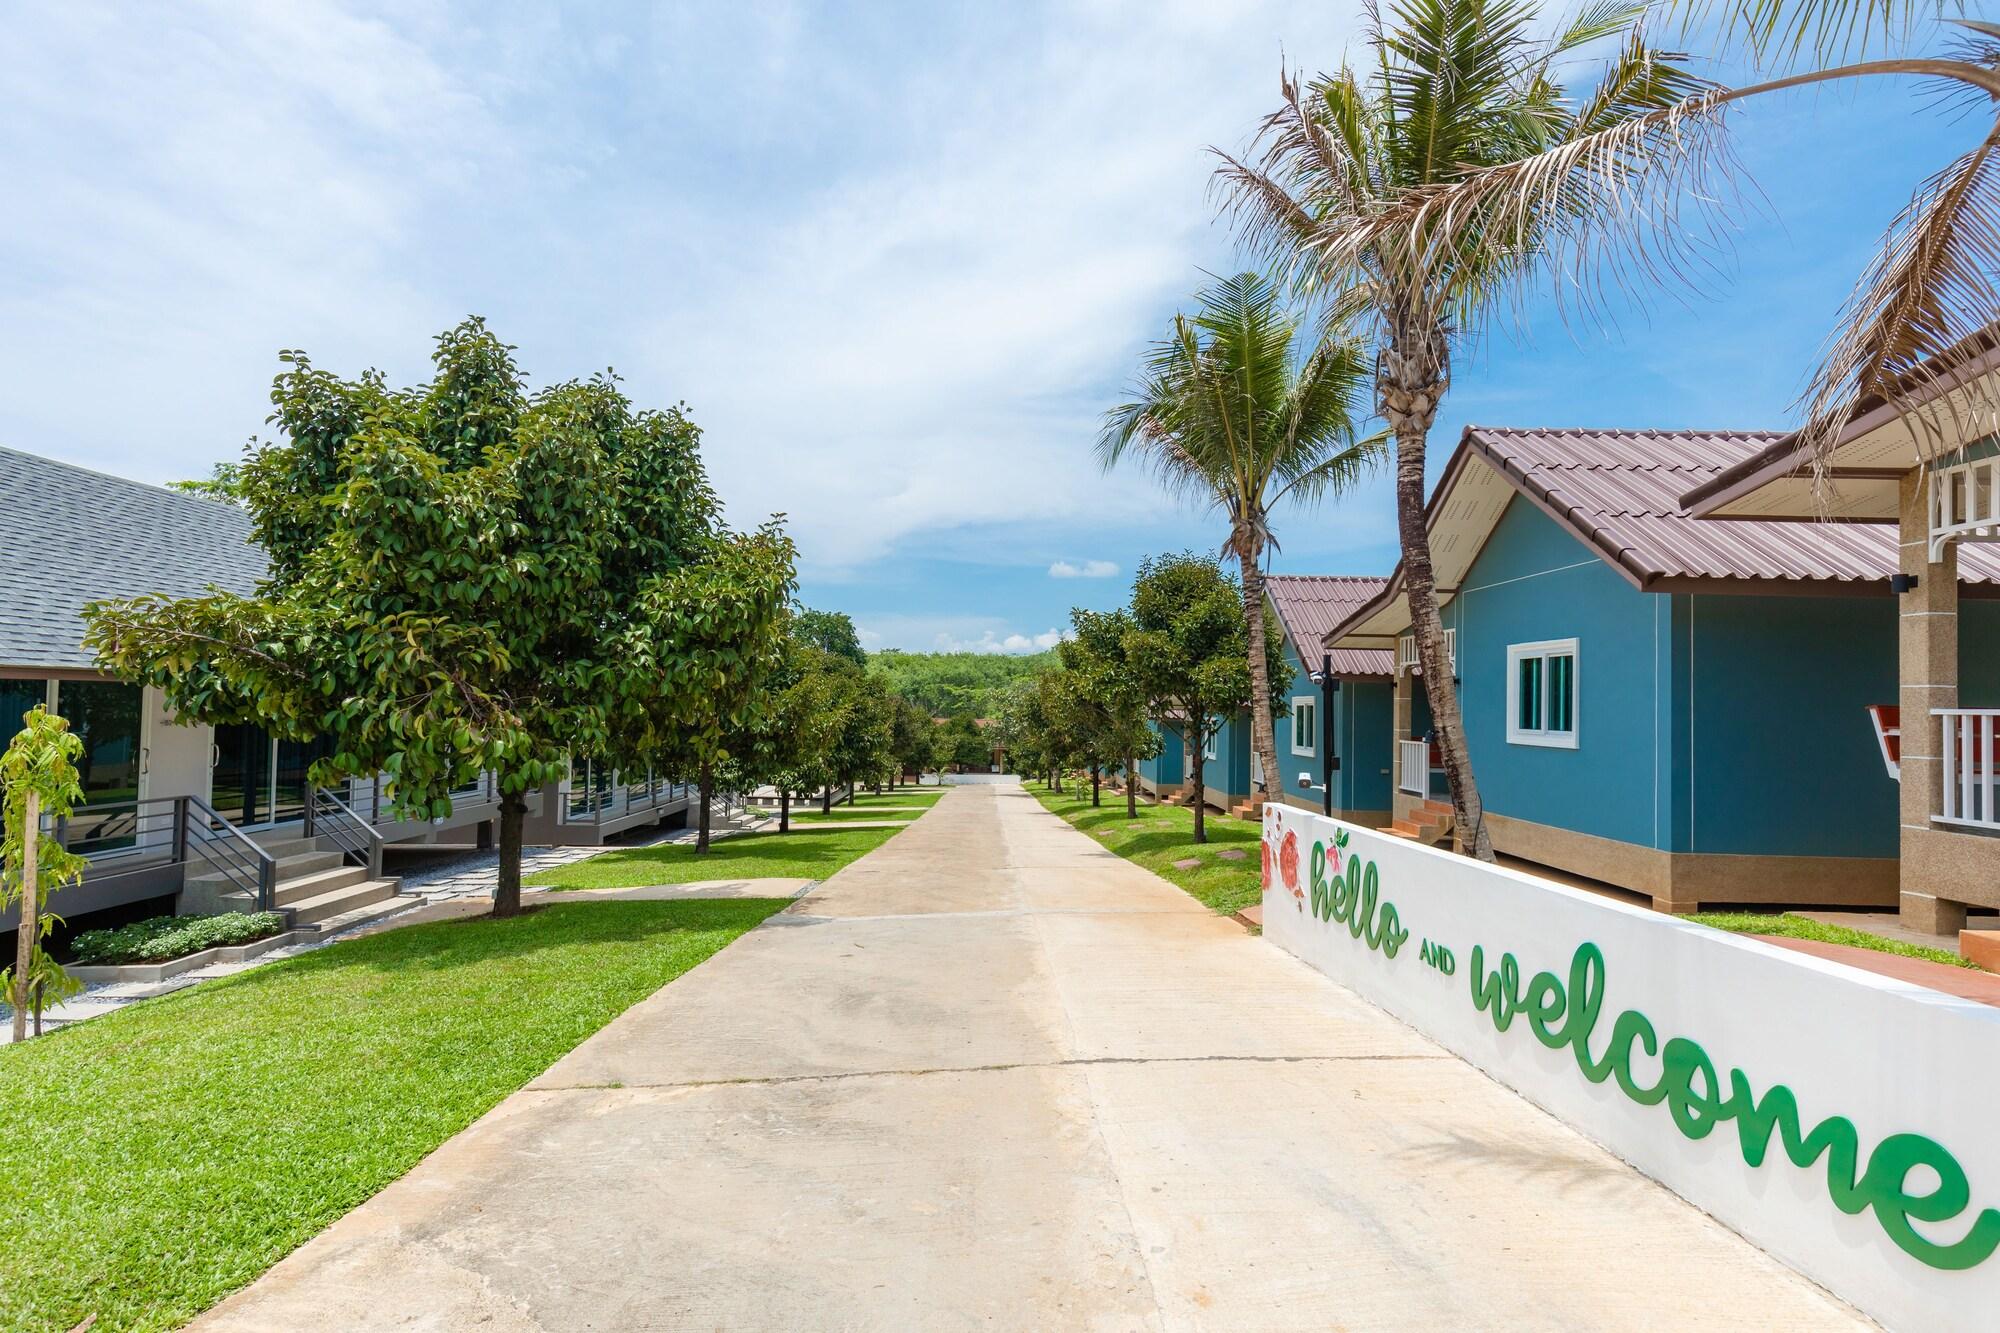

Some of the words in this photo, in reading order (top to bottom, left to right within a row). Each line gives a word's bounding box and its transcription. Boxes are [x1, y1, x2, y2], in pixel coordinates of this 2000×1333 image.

[1310, 840, 1409, 960] hello
[1419, 938, 1456, 976] AND
[1470, 942, 2000, 1271] welcome
